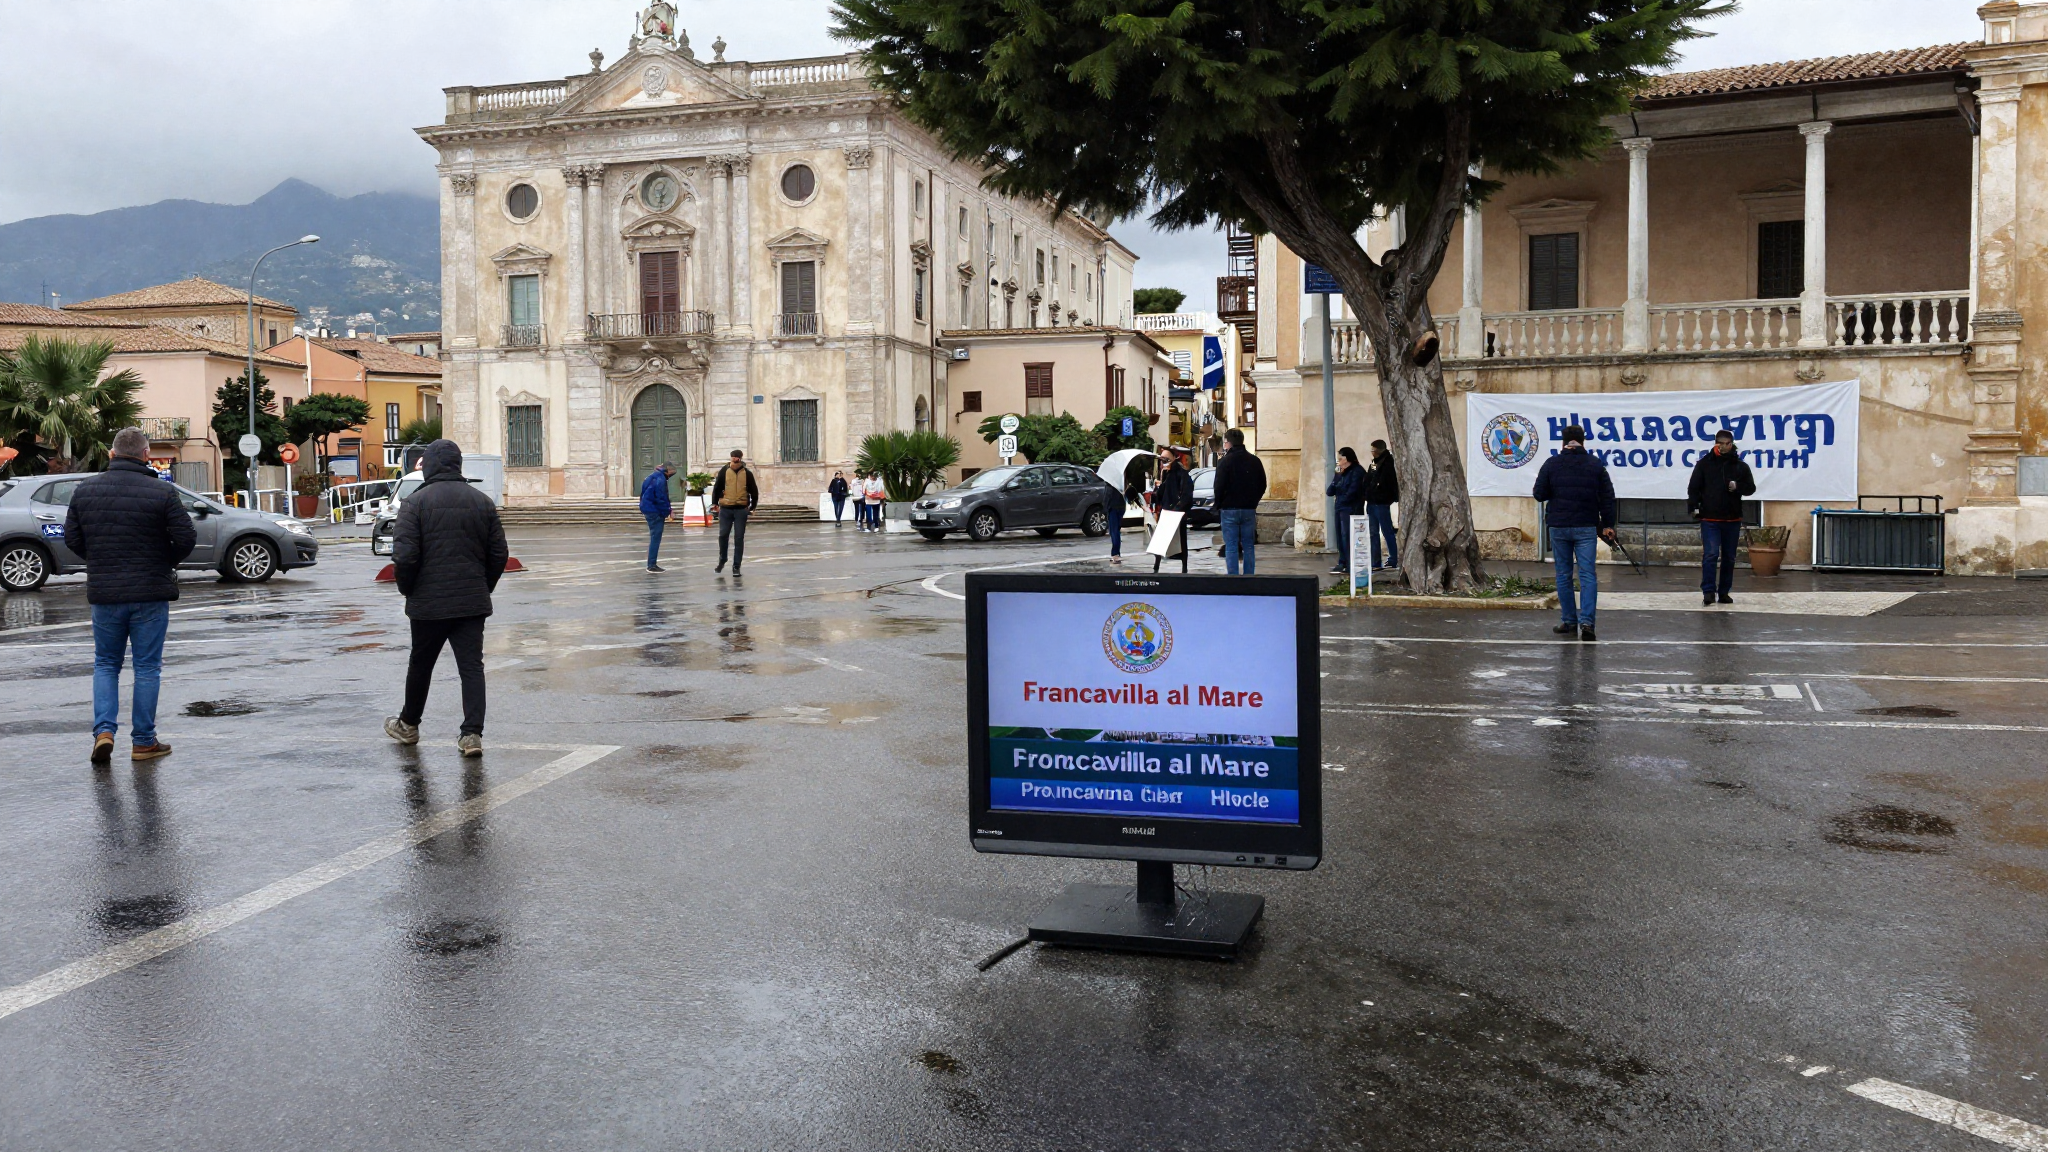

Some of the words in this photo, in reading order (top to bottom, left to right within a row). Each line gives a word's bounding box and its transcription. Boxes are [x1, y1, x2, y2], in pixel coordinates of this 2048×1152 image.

[1024, 681, 1158, 705] Francavilla
[1167, 683, 1189, 706] al
[1199, 685, 1264, 708] Mare
[1169, 753, 1192, 775] al
[1201, 753, 1270, 777] Mare
